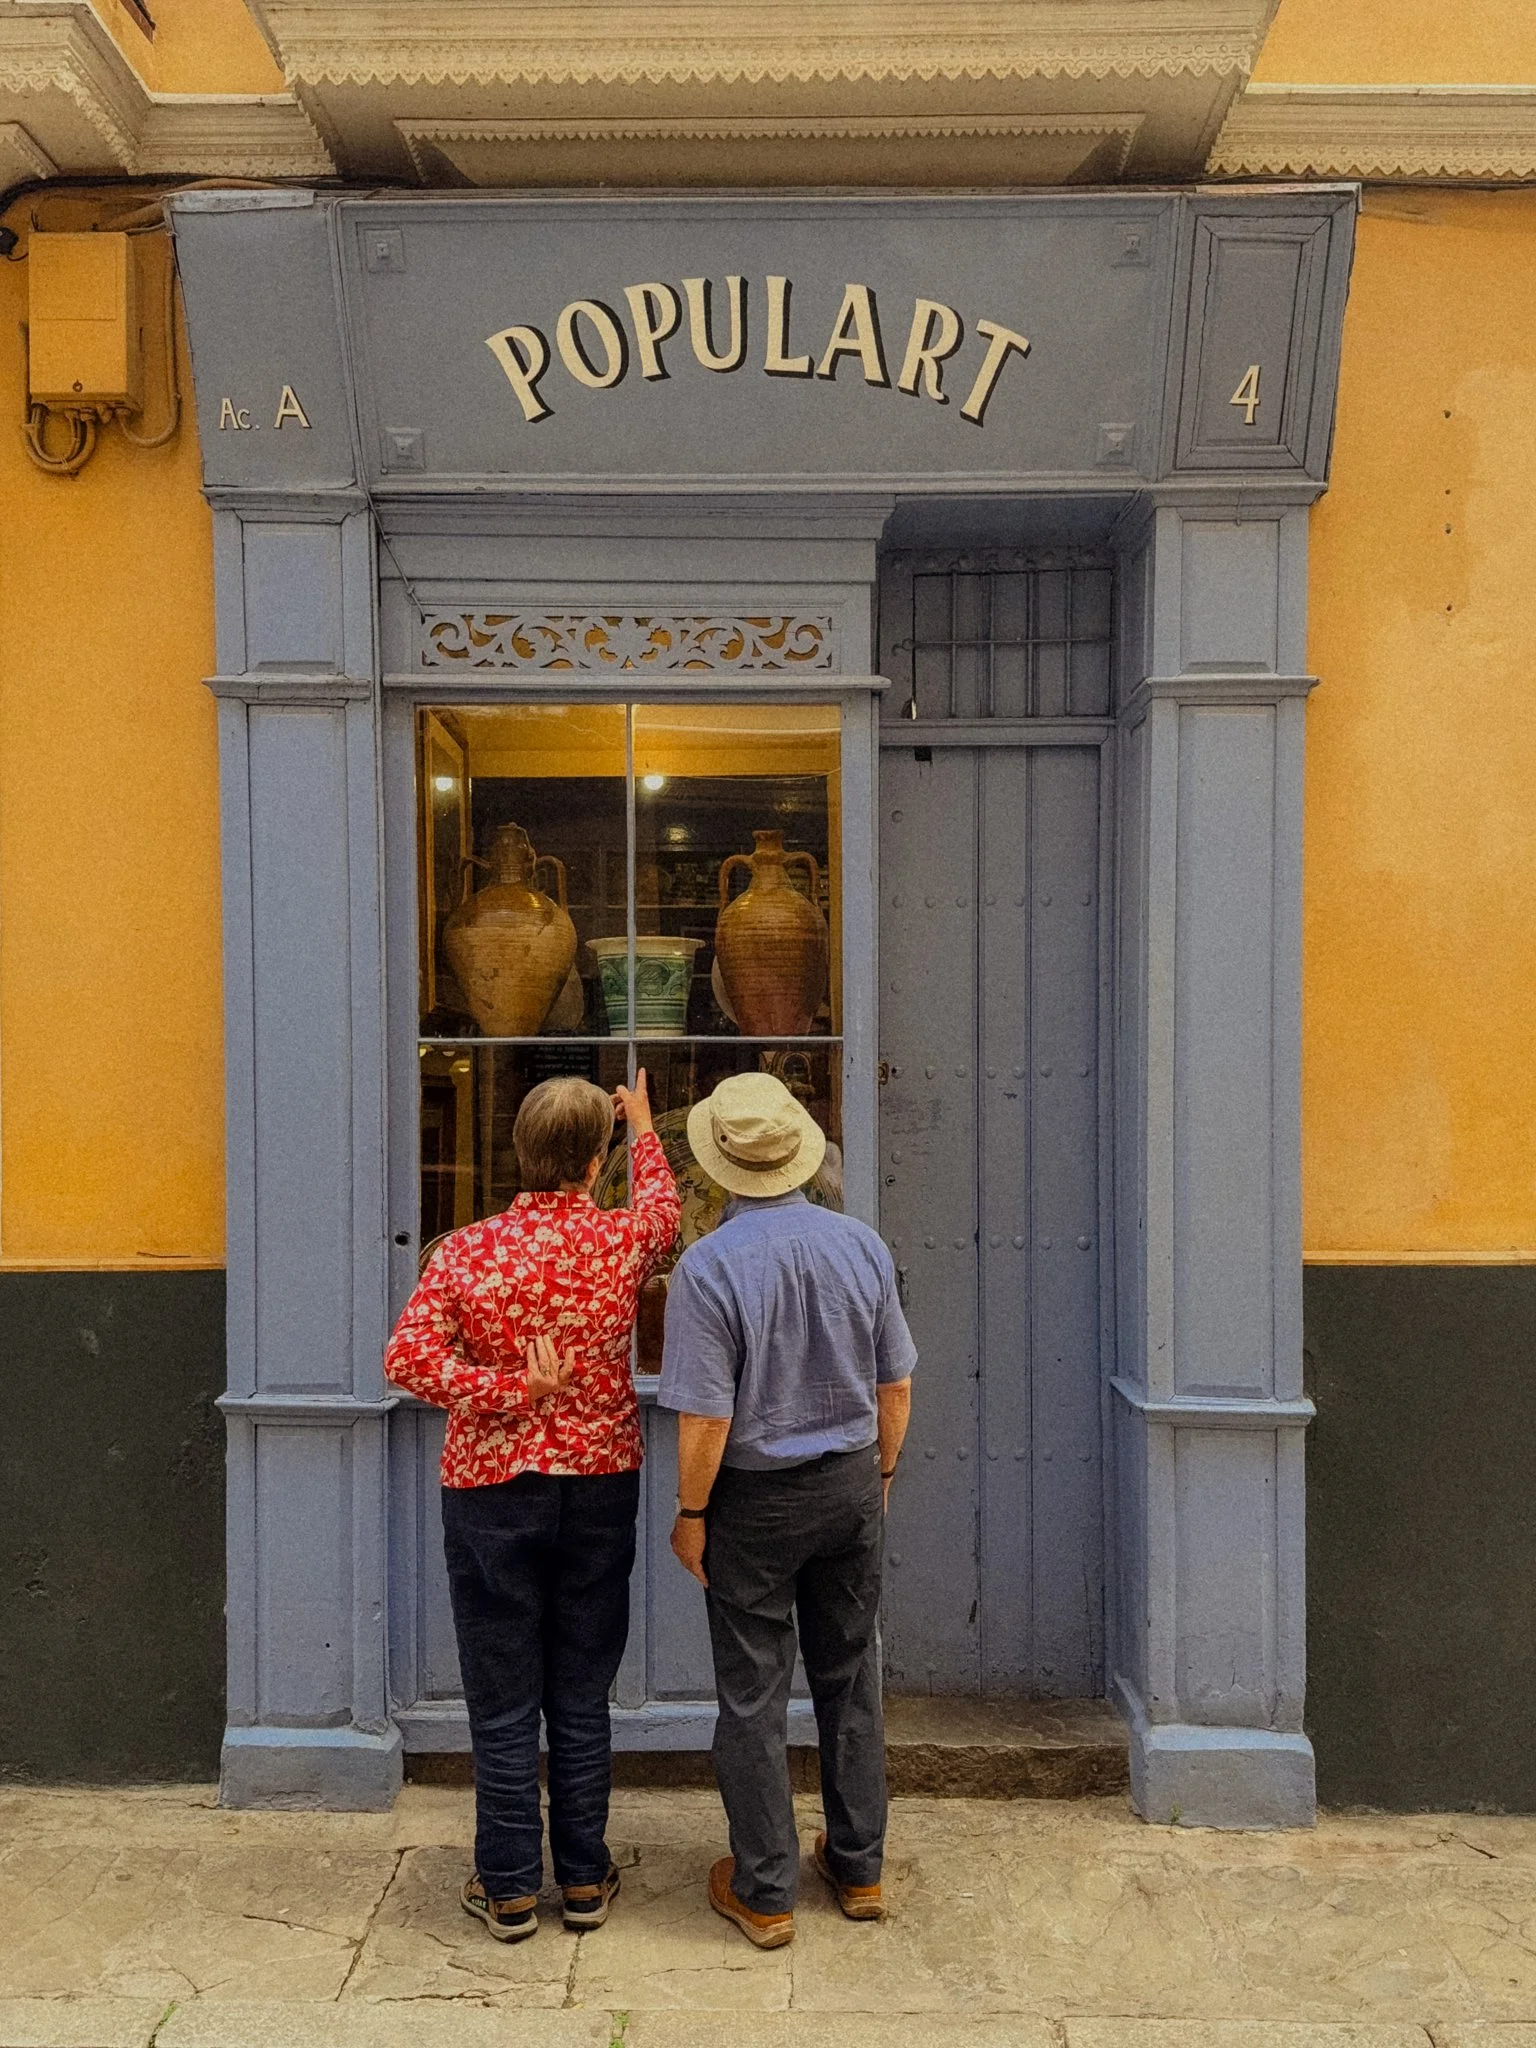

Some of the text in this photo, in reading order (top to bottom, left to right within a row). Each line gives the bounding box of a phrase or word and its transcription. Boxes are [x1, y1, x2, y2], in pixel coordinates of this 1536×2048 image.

[484, 275, 1031, 426] POPULART
[274, 385, 312, 429] A
[1229, 365, 1261, 425] 4
